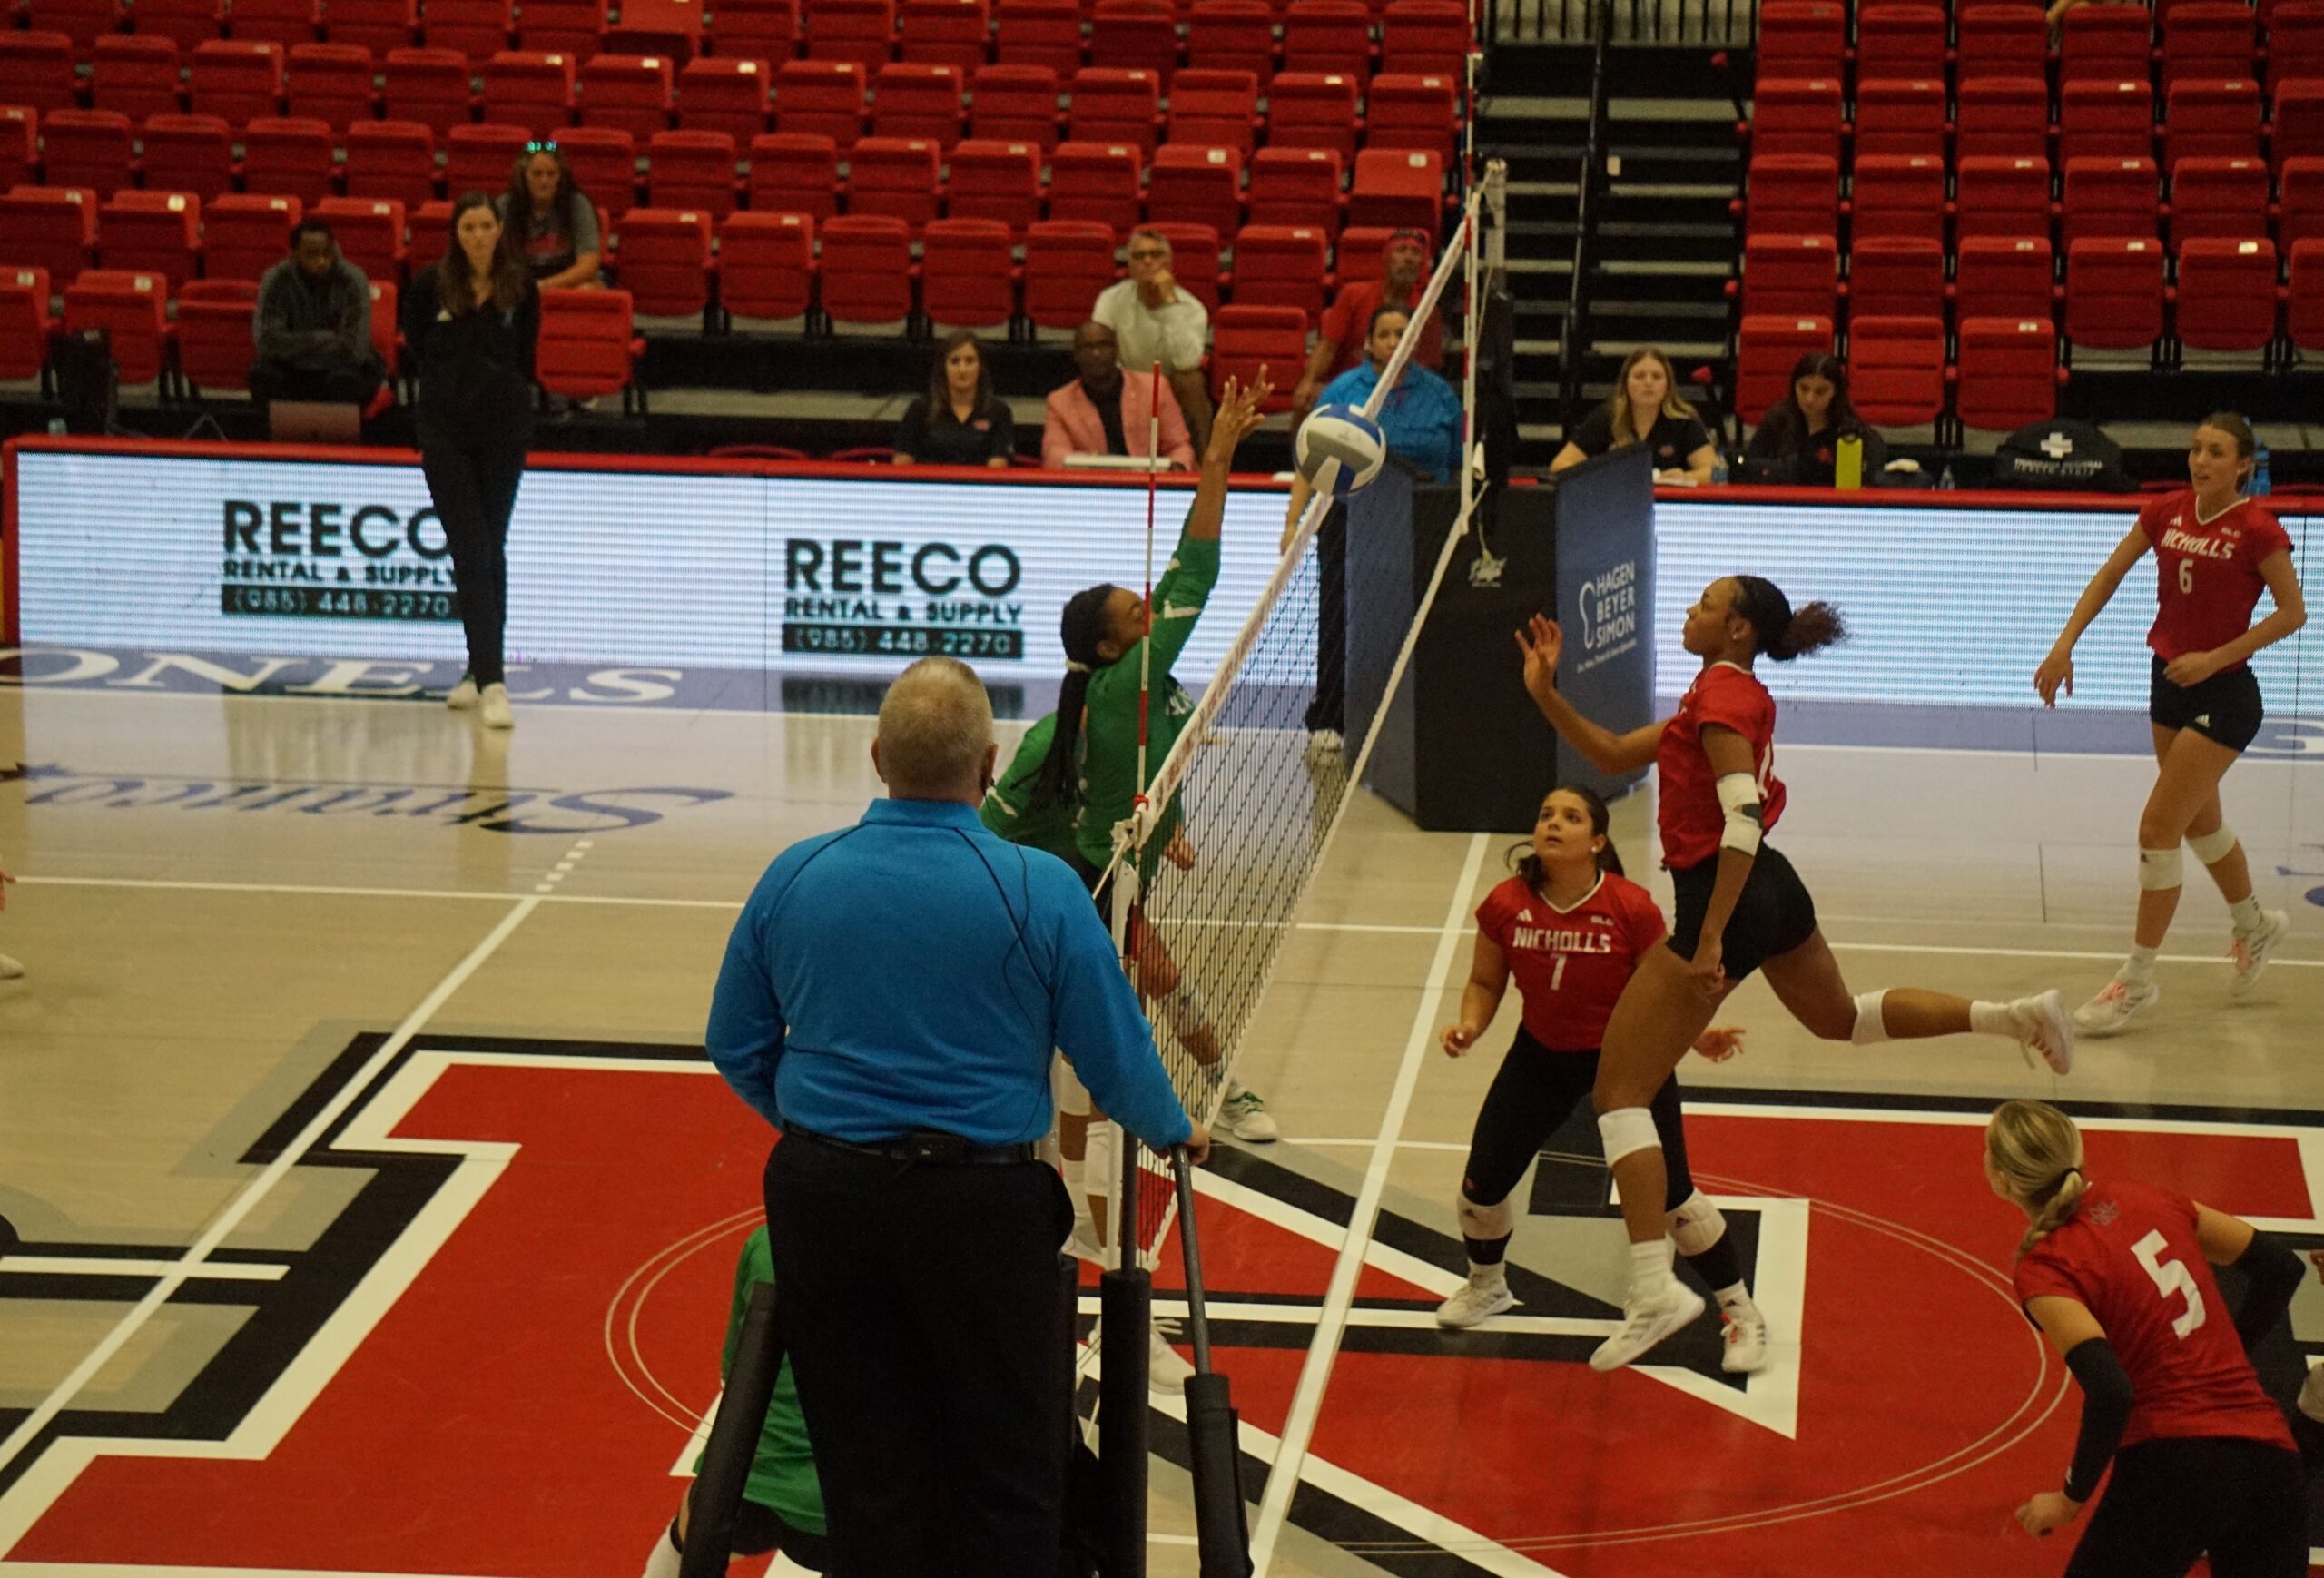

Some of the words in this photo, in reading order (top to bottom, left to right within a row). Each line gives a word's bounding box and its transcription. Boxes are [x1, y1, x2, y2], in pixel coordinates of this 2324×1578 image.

[224, 500, 454, 559] REECO
[2161, 528, 2236, 559] NICHOLLS
[224, 560, 325, 582] RENTAL
[786, 538, 1021, 596] REECO
[1597, 559, 1635, 597] HAGEN
[2179, 558, 2194, 595] 6
[786, 598, 882, 620] RENTAL
[926, 602, 1022, 624] SUPPLY
[1597, 586, 1635, 623] BEYER
[1597, 611, 1635, 649] SIMON
[1512, 926, 1611, 953] NICHOLLS
[1551, 952, 1567, 991] 7
[2130, 1228, 2206, 1340] 5
